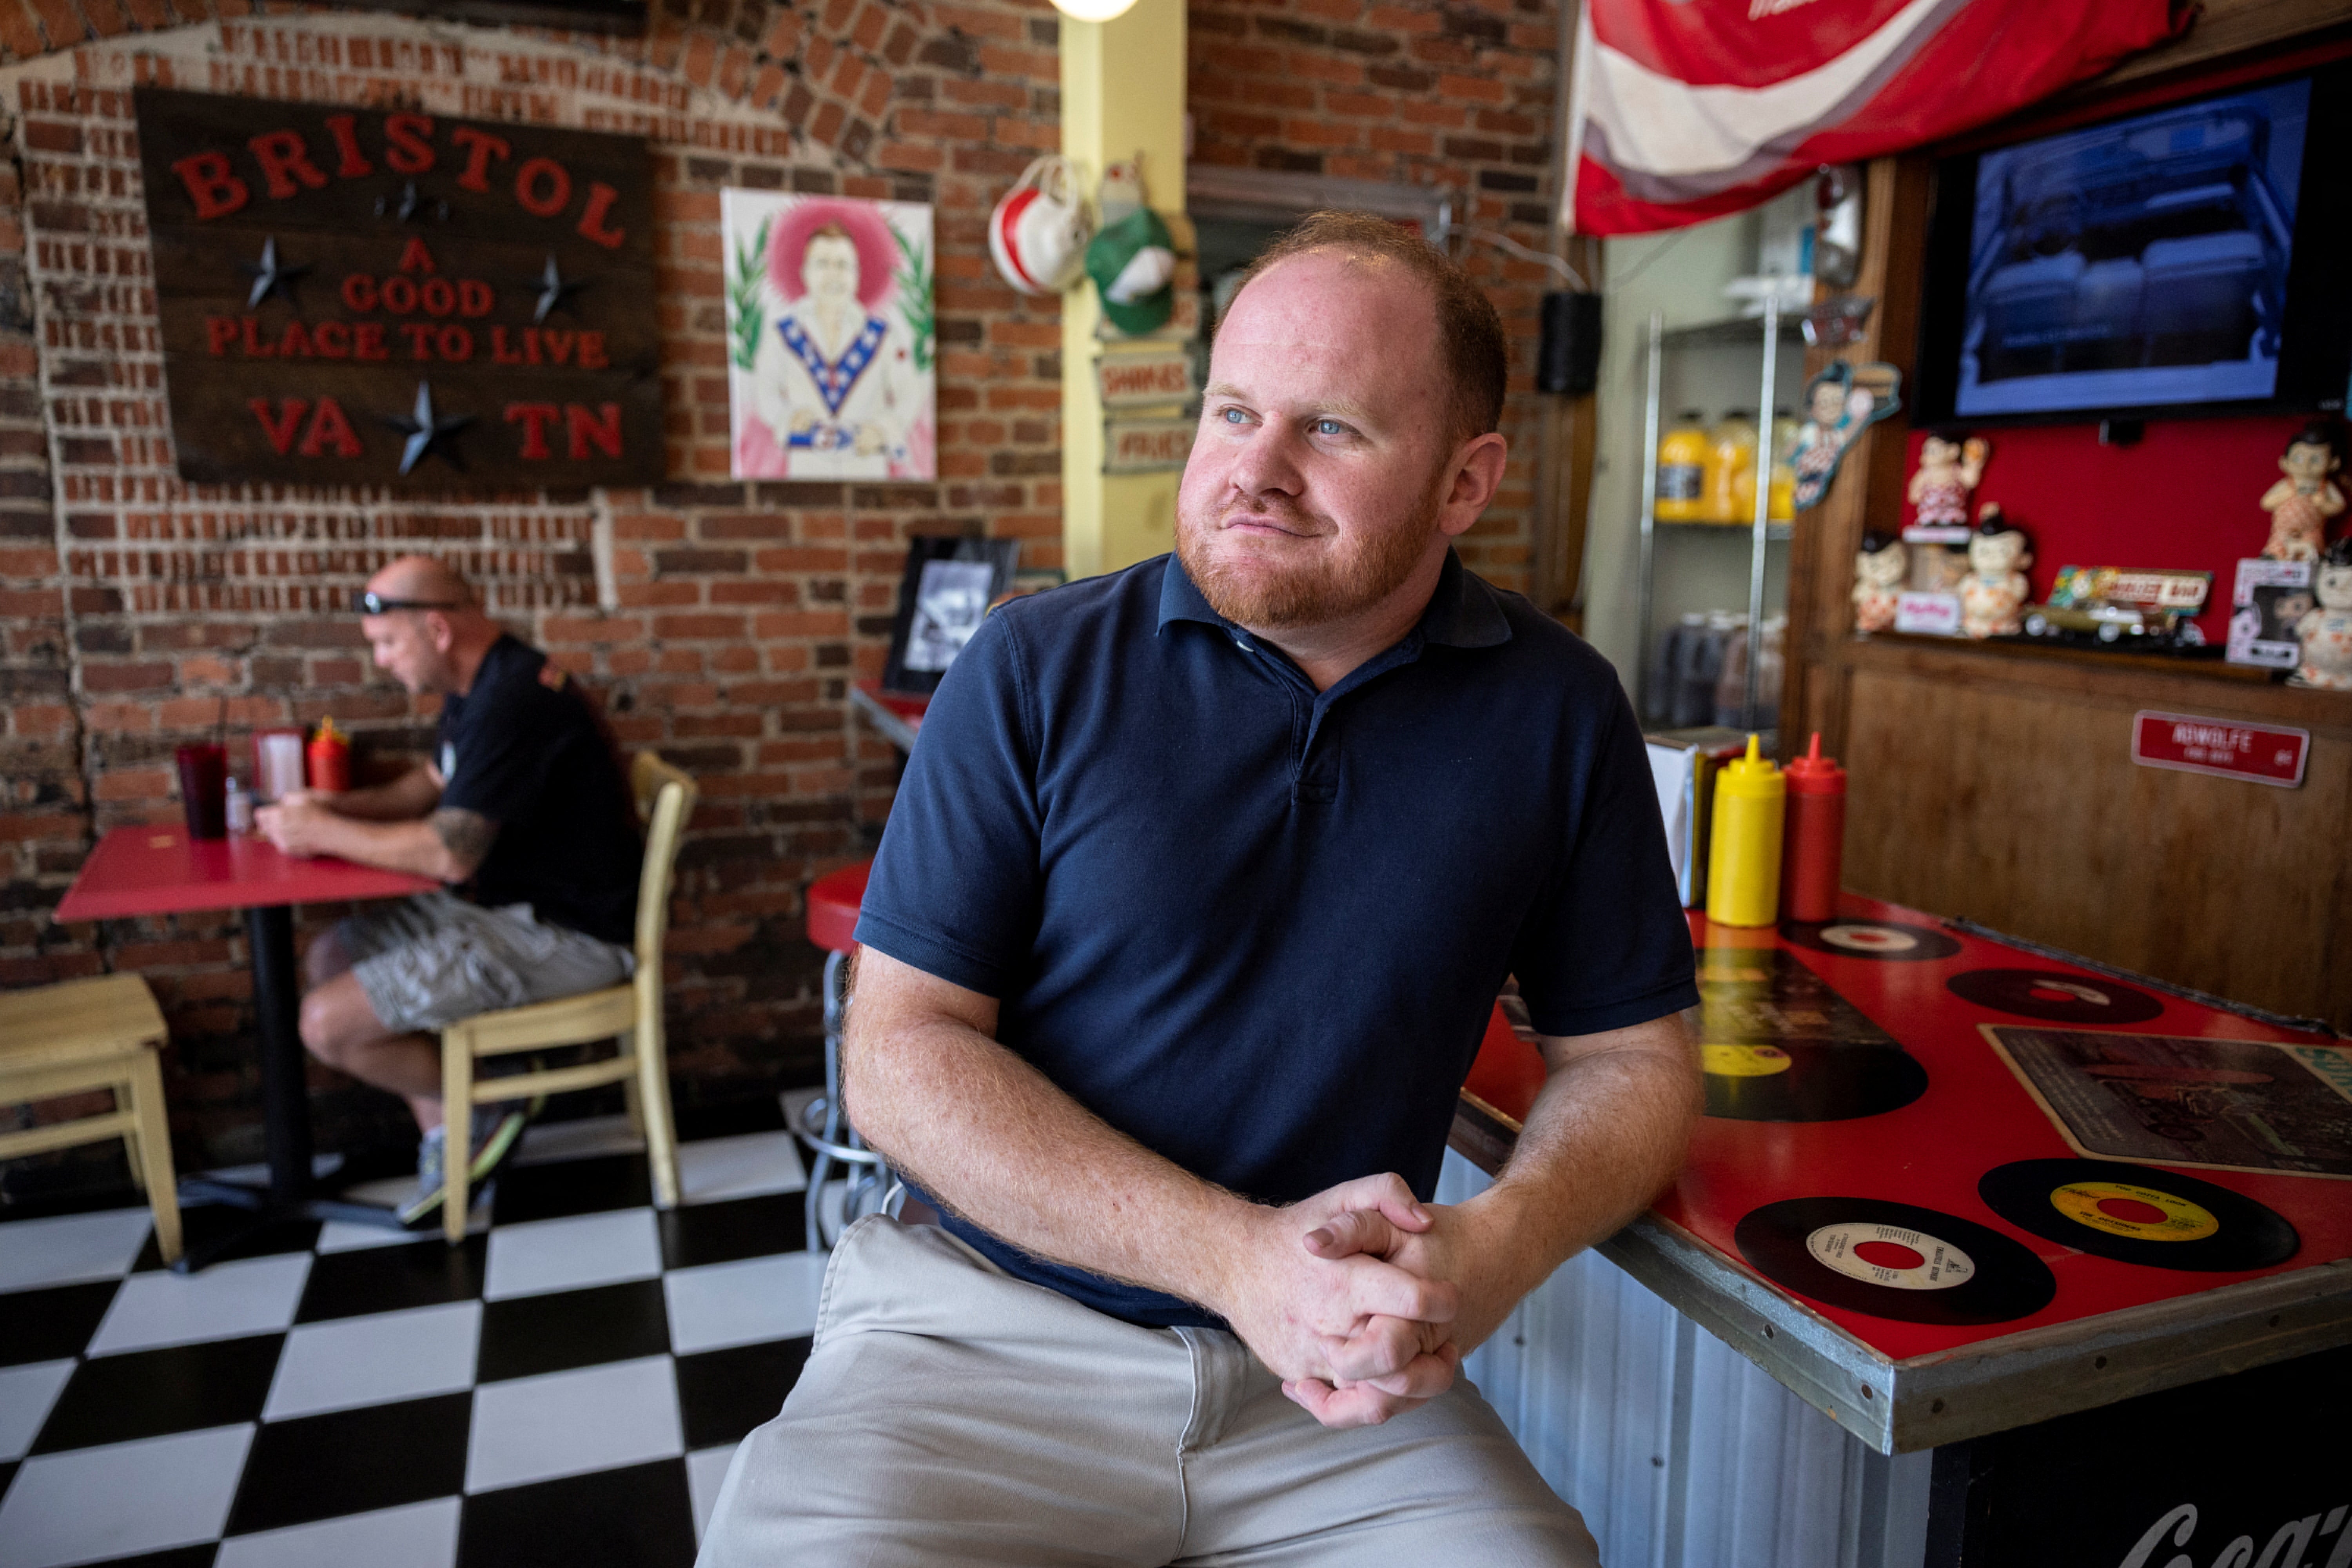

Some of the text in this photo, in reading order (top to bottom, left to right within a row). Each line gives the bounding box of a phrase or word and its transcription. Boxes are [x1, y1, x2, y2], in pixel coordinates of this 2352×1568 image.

[172, 112, 625, 249] BRISTOL
[399, 236, 434, 274] A
[342, 274, 493, 316] GOOD
[204, 316, 607, 368] PLACE TO LIVE
[249, 397, 362, 457] VA
[505, 403, 623, 459] TN
